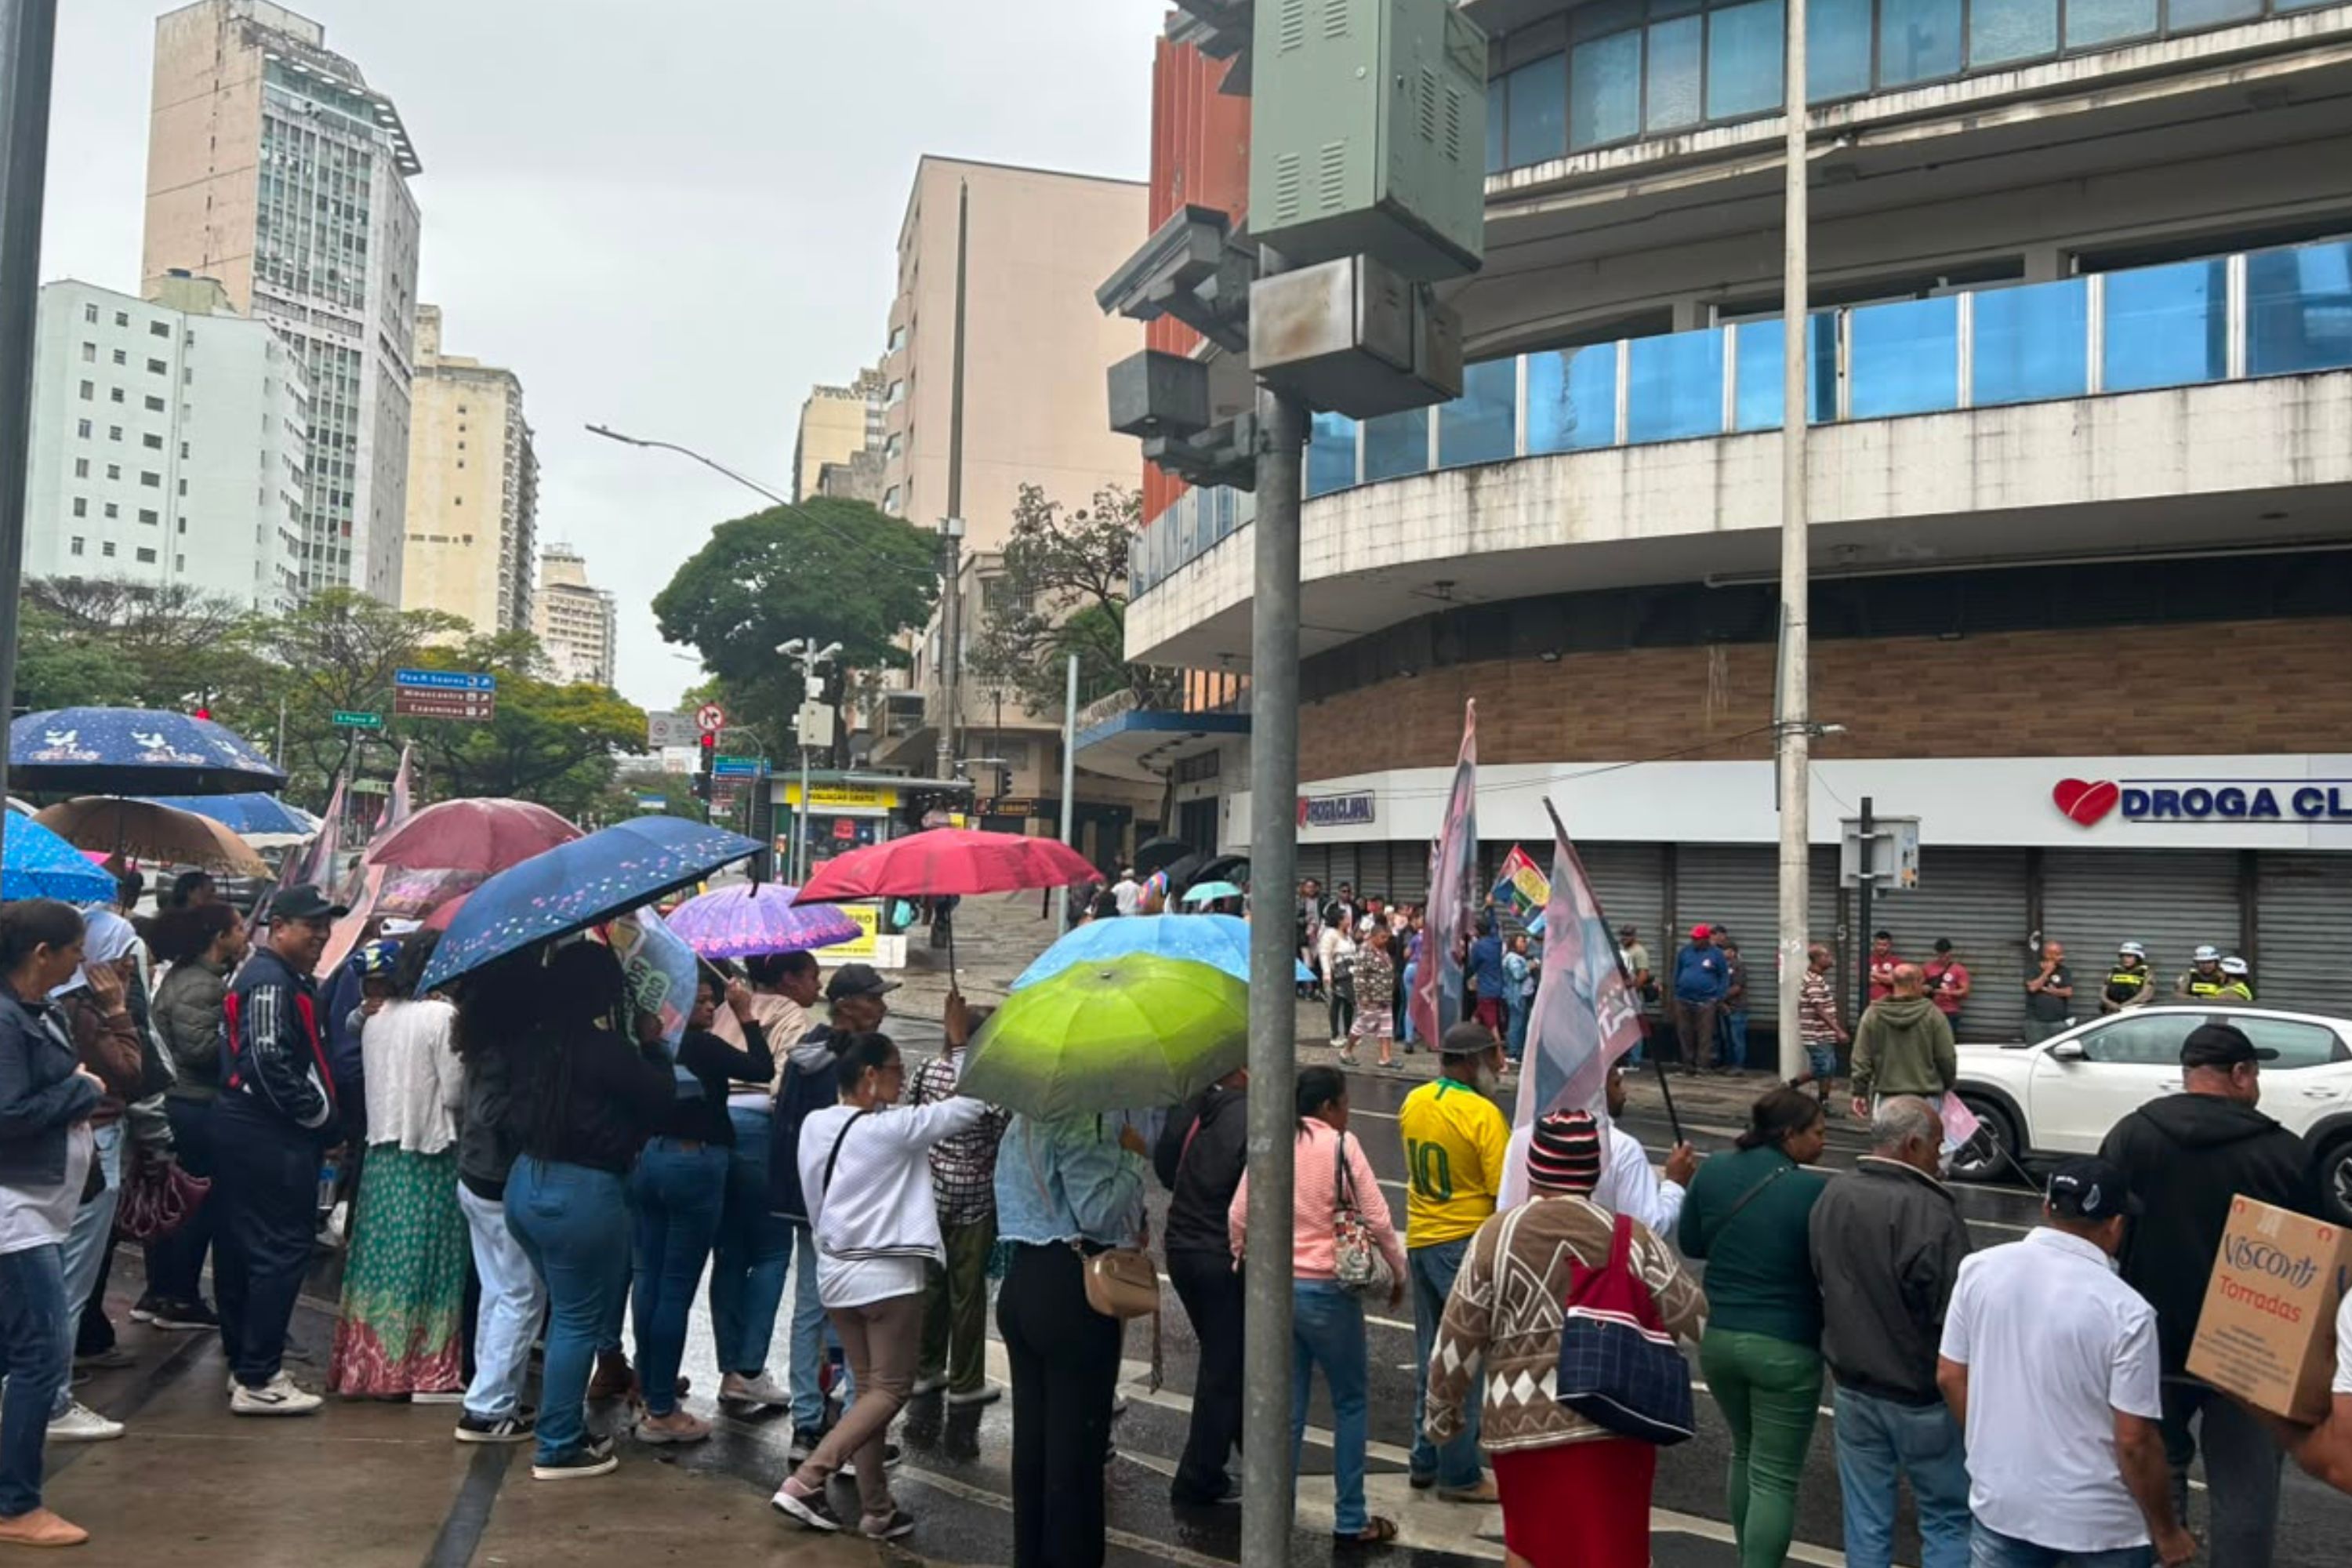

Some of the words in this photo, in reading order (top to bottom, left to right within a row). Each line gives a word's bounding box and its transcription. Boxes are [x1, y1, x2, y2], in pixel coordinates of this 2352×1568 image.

[2121, 787, 2281, 818] DROGA
[1407, 1138, 1452, 1200] 10
[2225, 1233, 2318, 1290] Visconti
[2219, 1274, 2302, 1323] Torradas
